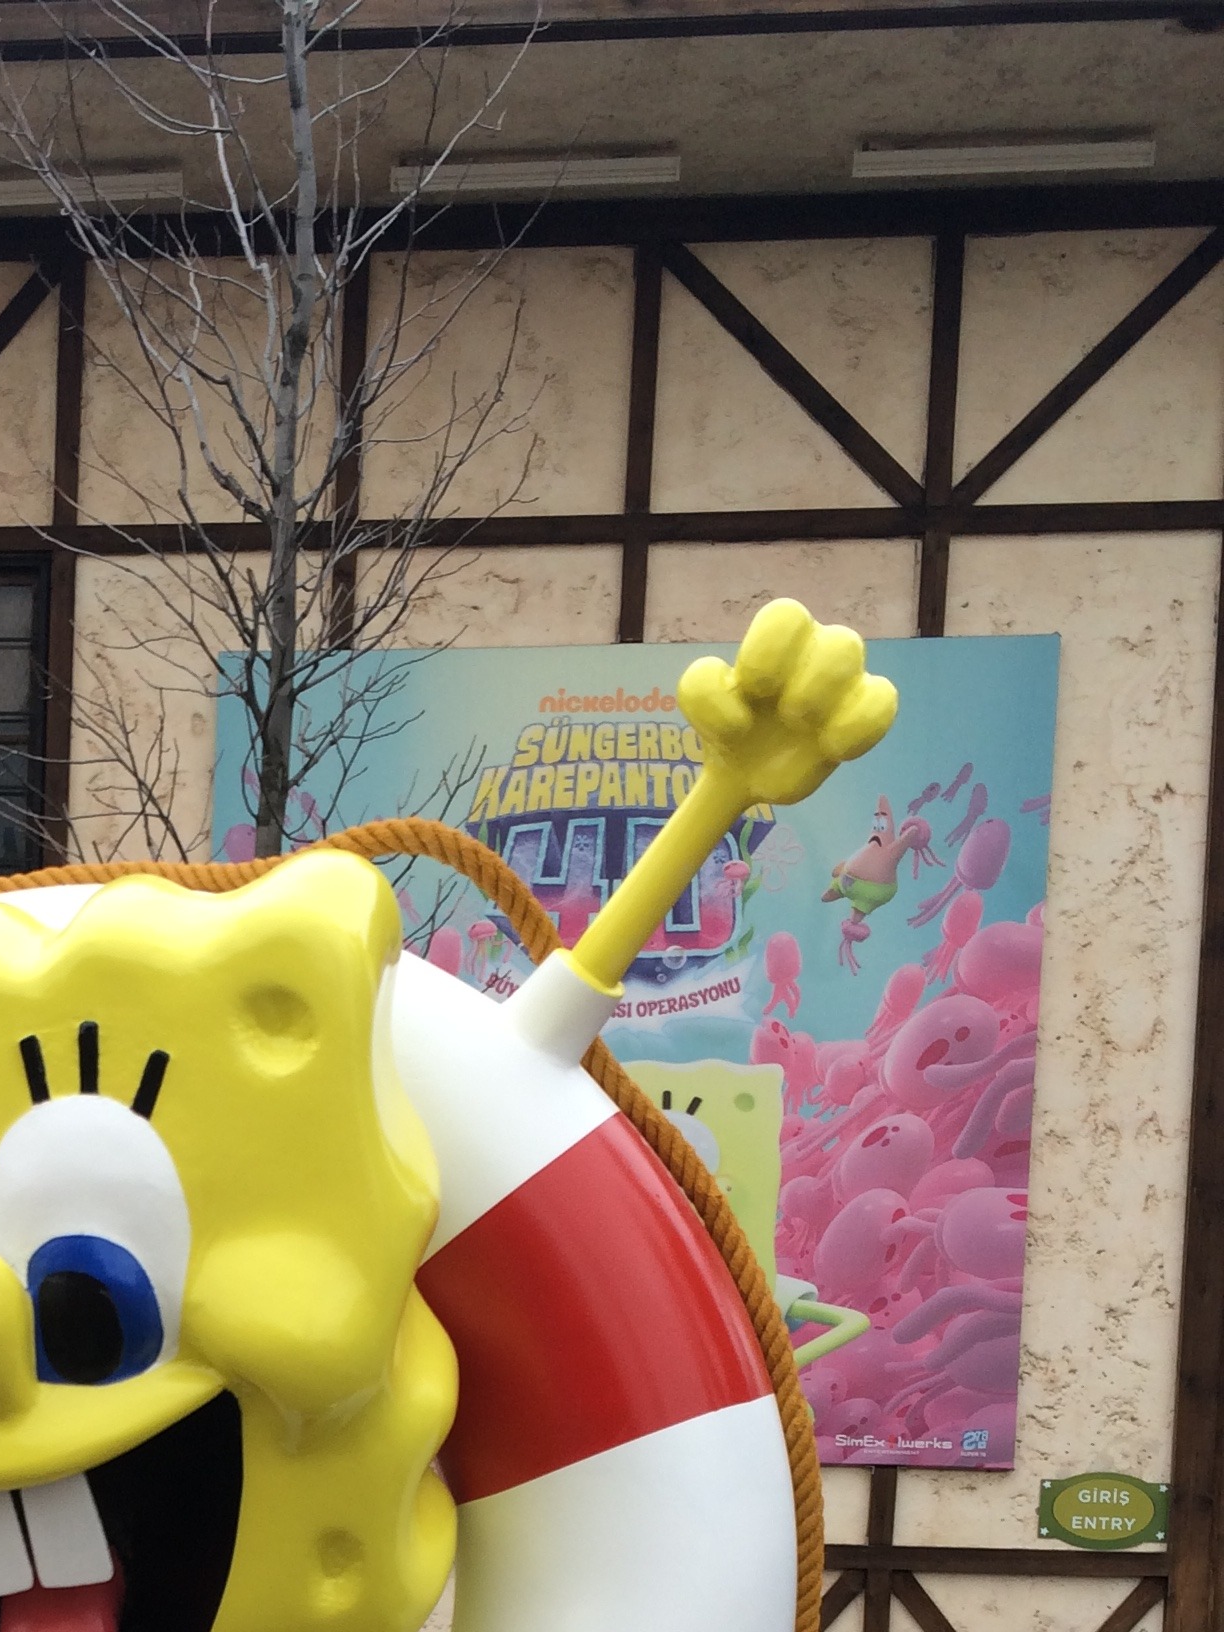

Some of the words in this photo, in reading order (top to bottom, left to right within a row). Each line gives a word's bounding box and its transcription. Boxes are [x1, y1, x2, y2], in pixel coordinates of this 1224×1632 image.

[538, 686, 678, 713] nickelode
[513, 715, 704, 767] SÜNGERBO
[467, 761, 775, 824] KAREPANTO
[635, 976, 742, 1018] OPERASYONU
[835, 1434, 886, 1448] SimEx
[1078, 1487, 1131, 1506] GİRİŞ
[1071, 1516, 1137, 1532] ENTRY
